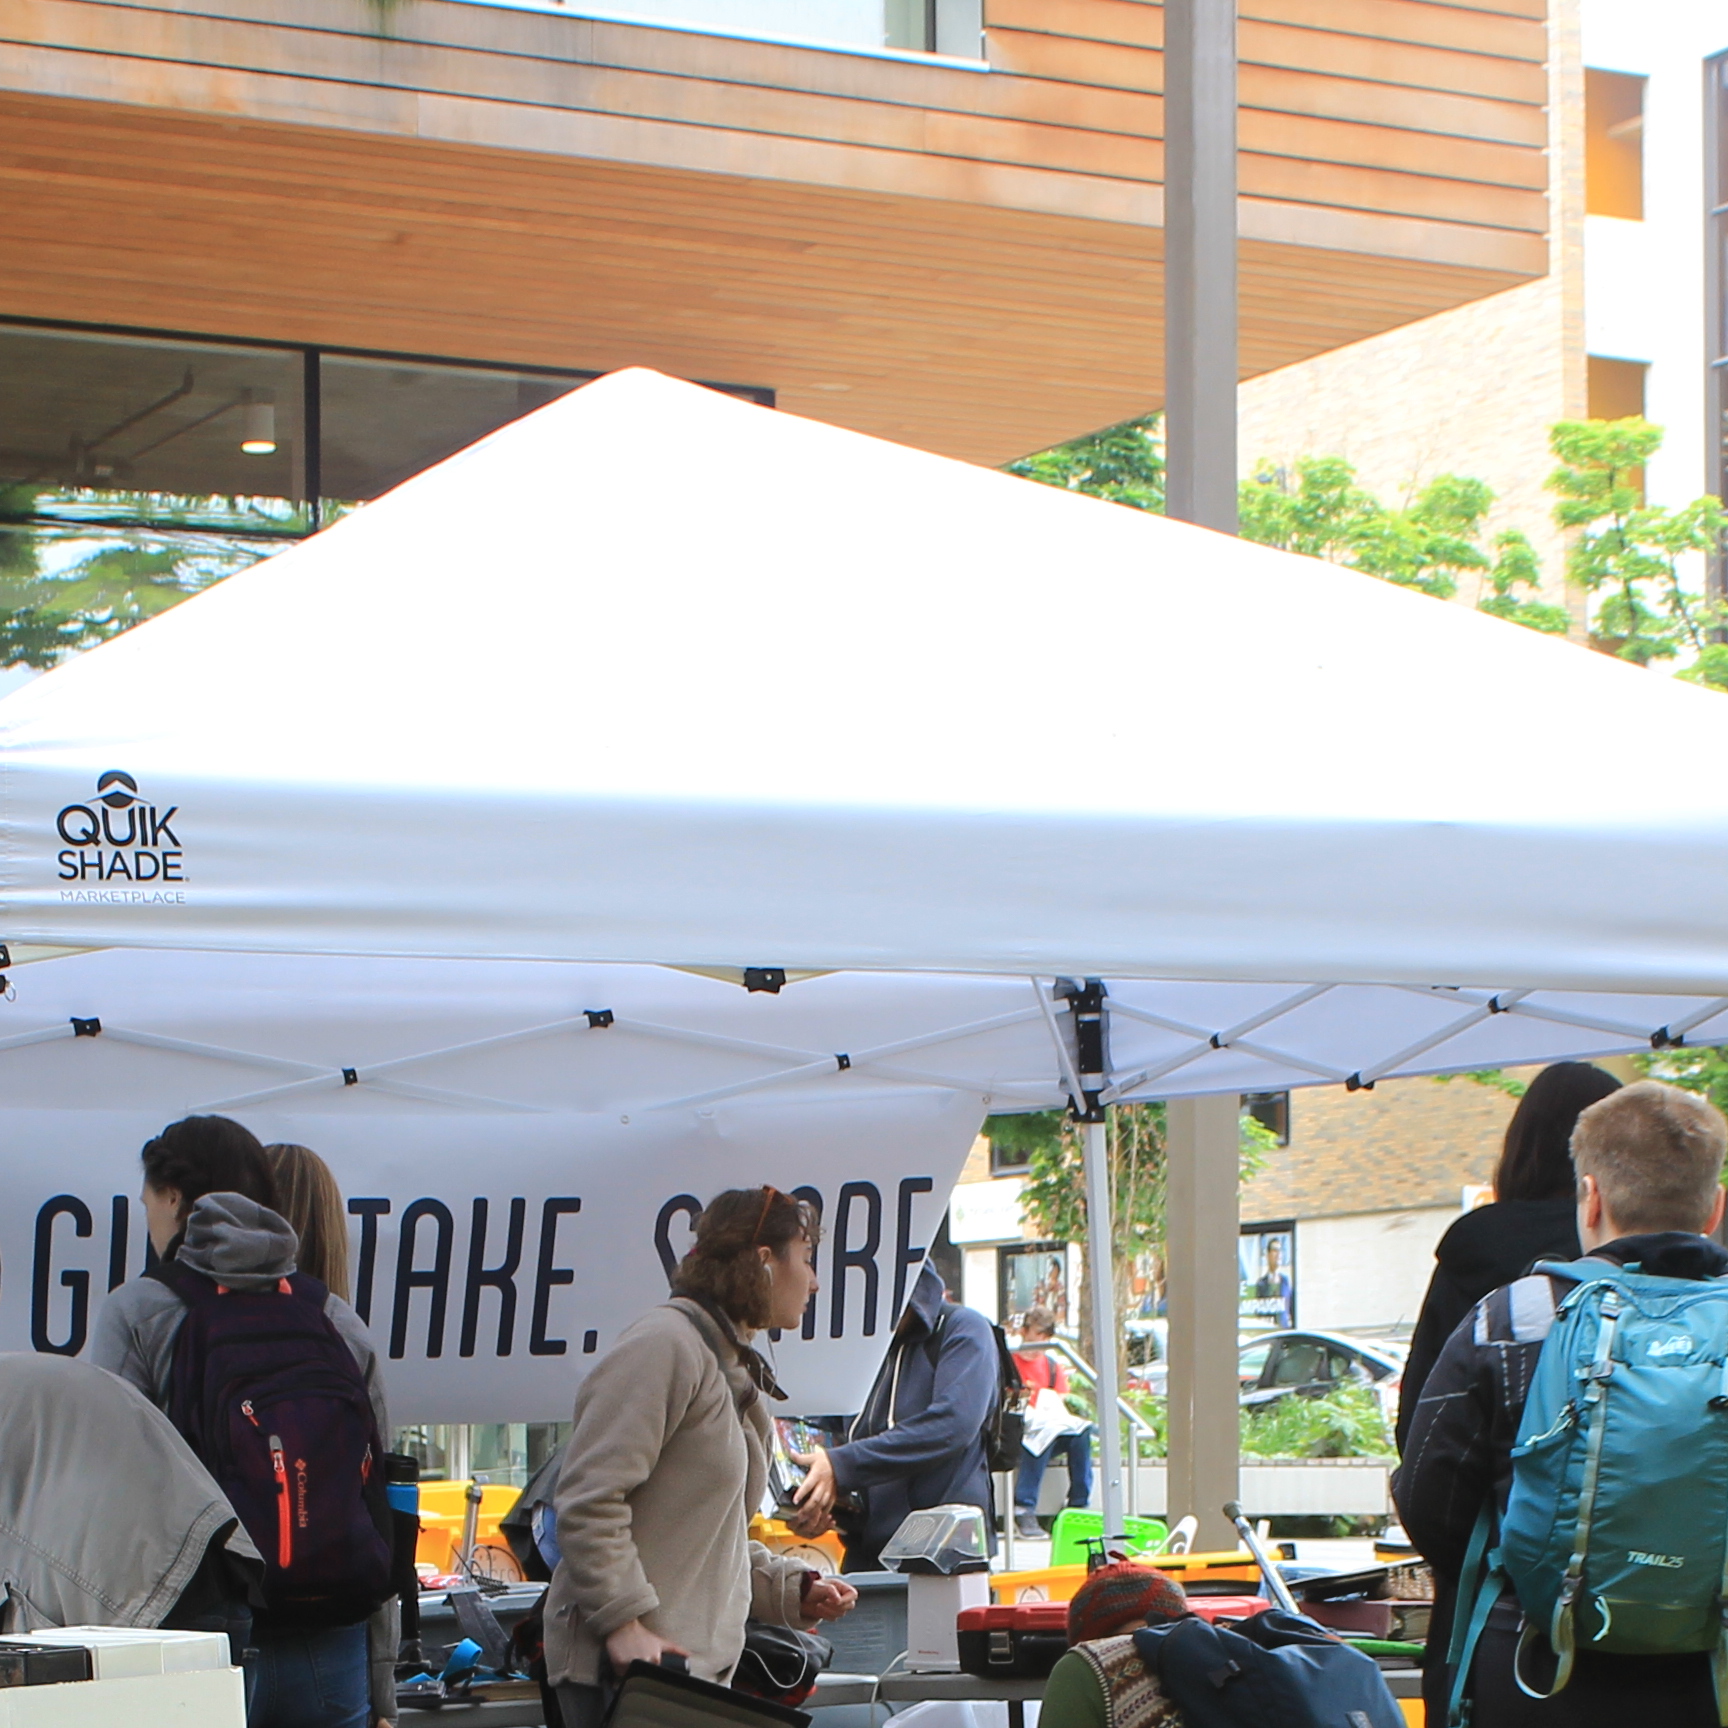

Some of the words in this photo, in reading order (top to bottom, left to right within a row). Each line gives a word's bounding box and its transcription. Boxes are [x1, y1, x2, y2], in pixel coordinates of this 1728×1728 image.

[56, 804, 181, 847] QUIK
[58, 850, 184, 882] SHADE
[60, 889, 186, 904] MARKETPLACE
[347, 1196, 598, 1359] TAKE.
[653, 1176, 933, 1342] SARE
[297, 1472, 309, 1528] Columbia
